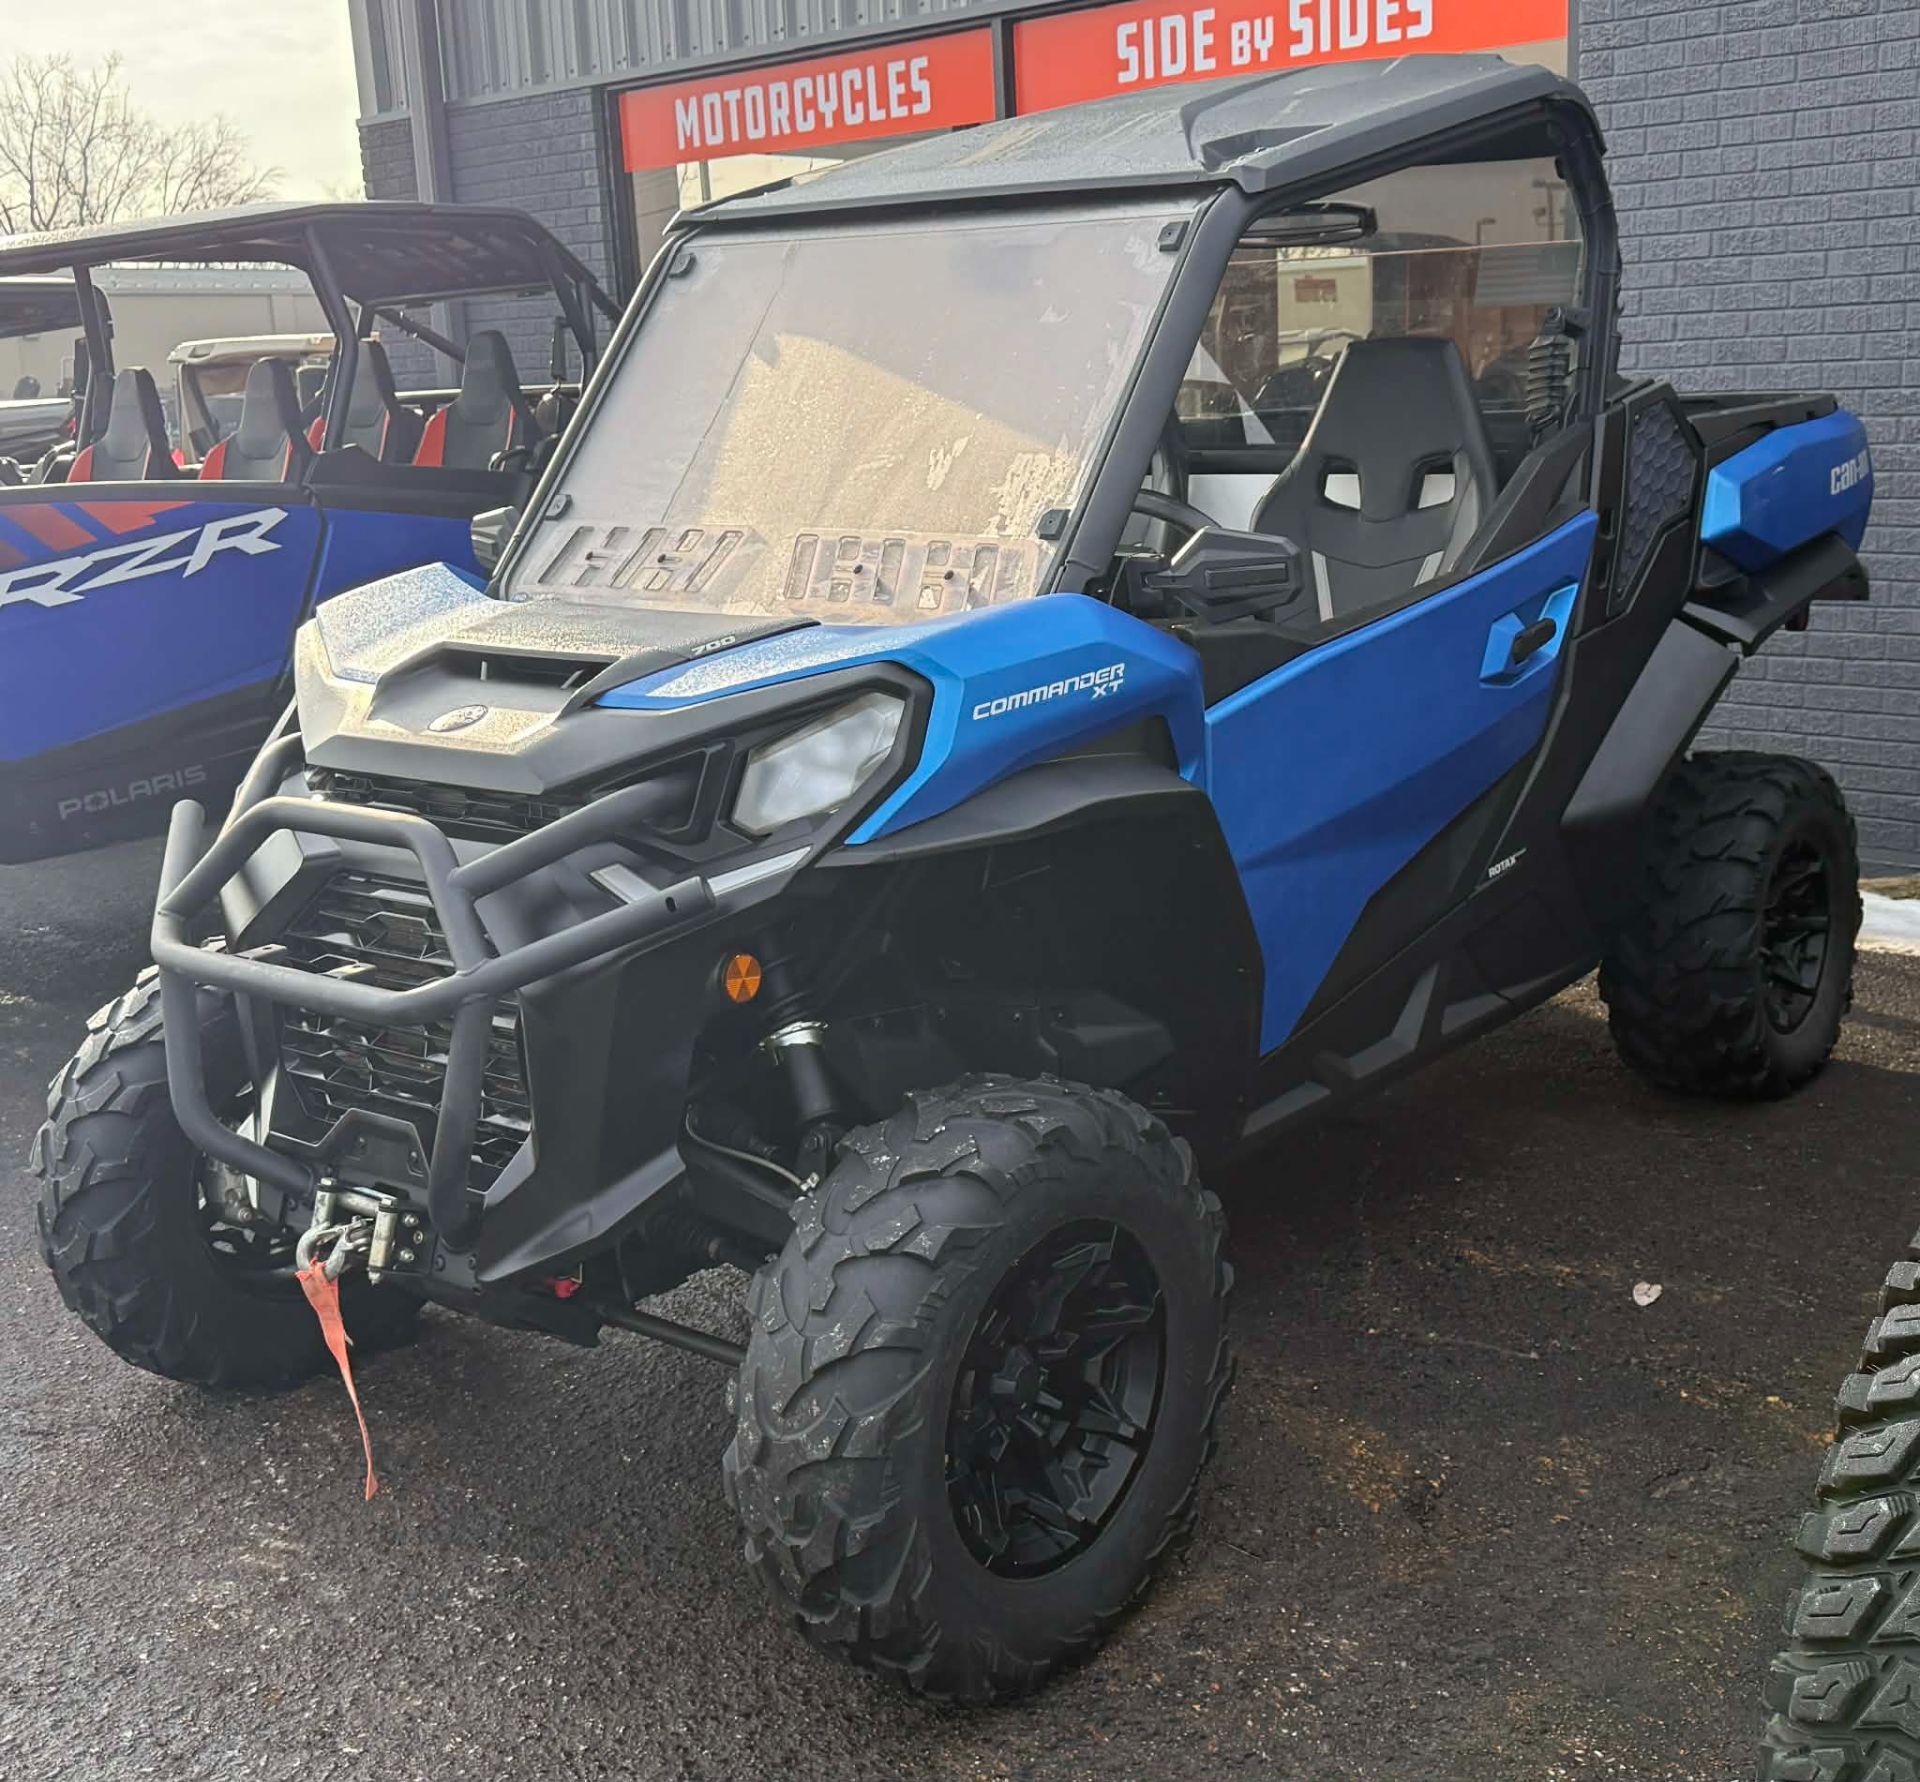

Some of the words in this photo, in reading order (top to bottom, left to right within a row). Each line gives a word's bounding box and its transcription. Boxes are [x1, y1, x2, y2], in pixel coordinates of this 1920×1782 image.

[1116, 8, 1216, 84] SIDE
[1231, 16, 1274, 67] BY
[1289, 0, 1433, 58] SIDES
[674, 56, 931, 150] MOTORCYCLES
[0, 507, 288, 608] RZR
[691, 635, 736, 656] 700
[972, 663, 1126, 721] COMMANDER
[1091, 679, 1124, 700] XT
[57, 764, 207, 820] POLARIS
[1488, 851, 1521, 878] ROTAX
